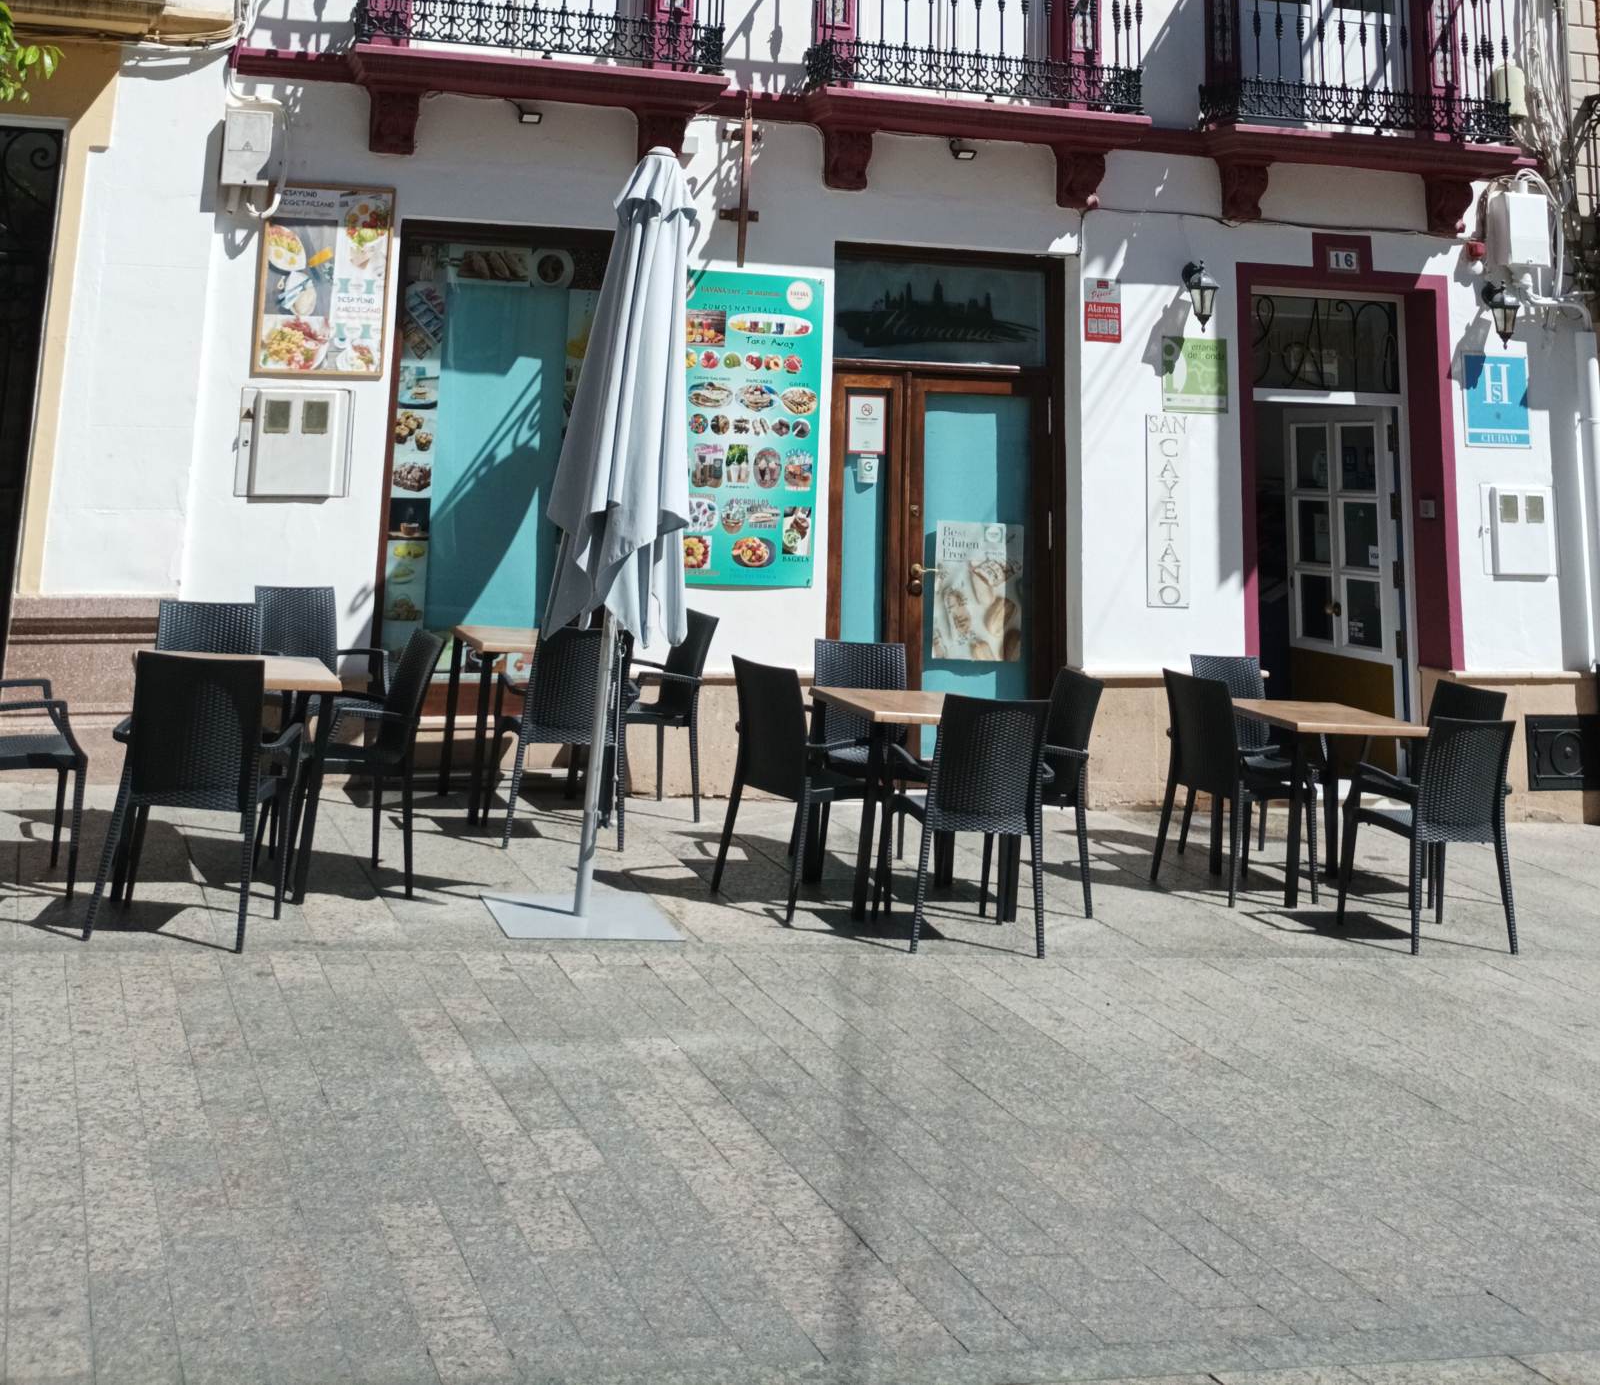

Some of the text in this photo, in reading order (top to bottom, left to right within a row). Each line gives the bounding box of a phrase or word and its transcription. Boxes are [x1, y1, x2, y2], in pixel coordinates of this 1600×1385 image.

[282, 189, 318, 198] ESAYUNO
[1334, 252, 1354, 268] 16
[1087, 303, 1119, 314] Alarma
[1187, 351, 1198, 359] de
[1148, 415, 1188, 434] SAN
[1480, 433, 1518, 443] CIUDAD
[1157, 437, 1181, 606] CAYETANO
[942, 537, 979, 549] Gluten
[942, 548, 967, 559] Free
